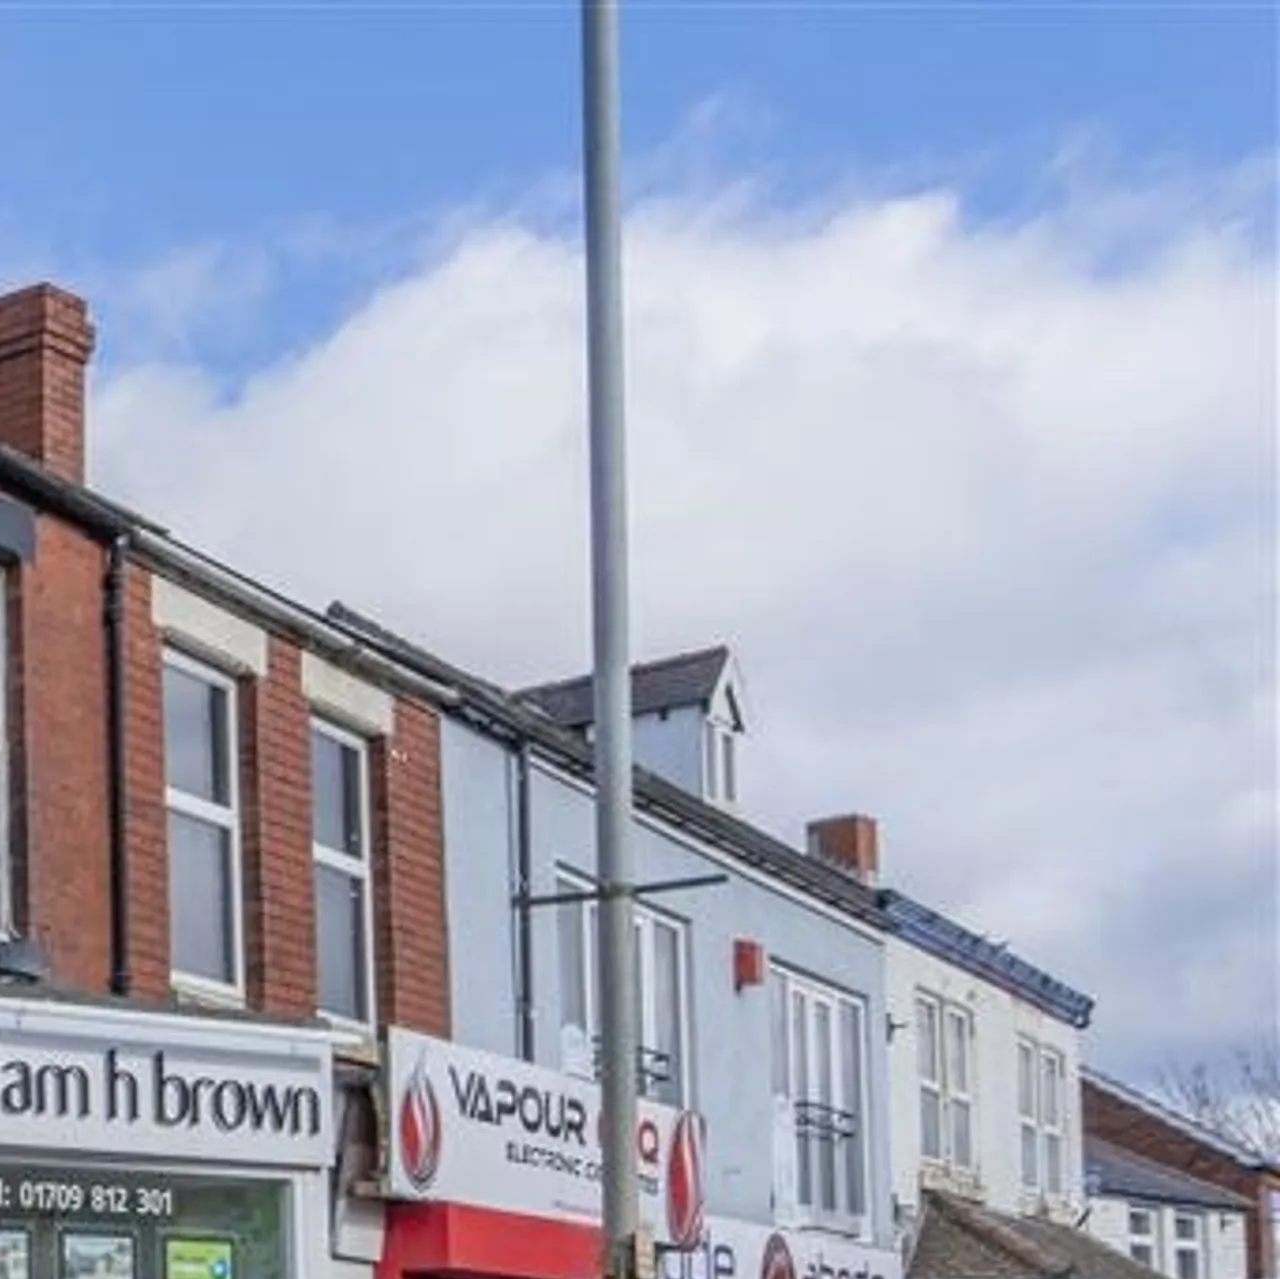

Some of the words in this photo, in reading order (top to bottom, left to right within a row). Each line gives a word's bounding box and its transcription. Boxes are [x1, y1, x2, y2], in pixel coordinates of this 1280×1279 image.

[105, 1049, 140, 1124] h
[153, 1051, 322, 1138] brown
[448, 1065, 587, 1147] VAPOUR
[505, 1141, 581, 1177] ELECTRONIC
[20, 1182, 83, 1211] 01709
[90, 1186, 127, 1213] 812
[136, 1189, 172, 1216] 301
